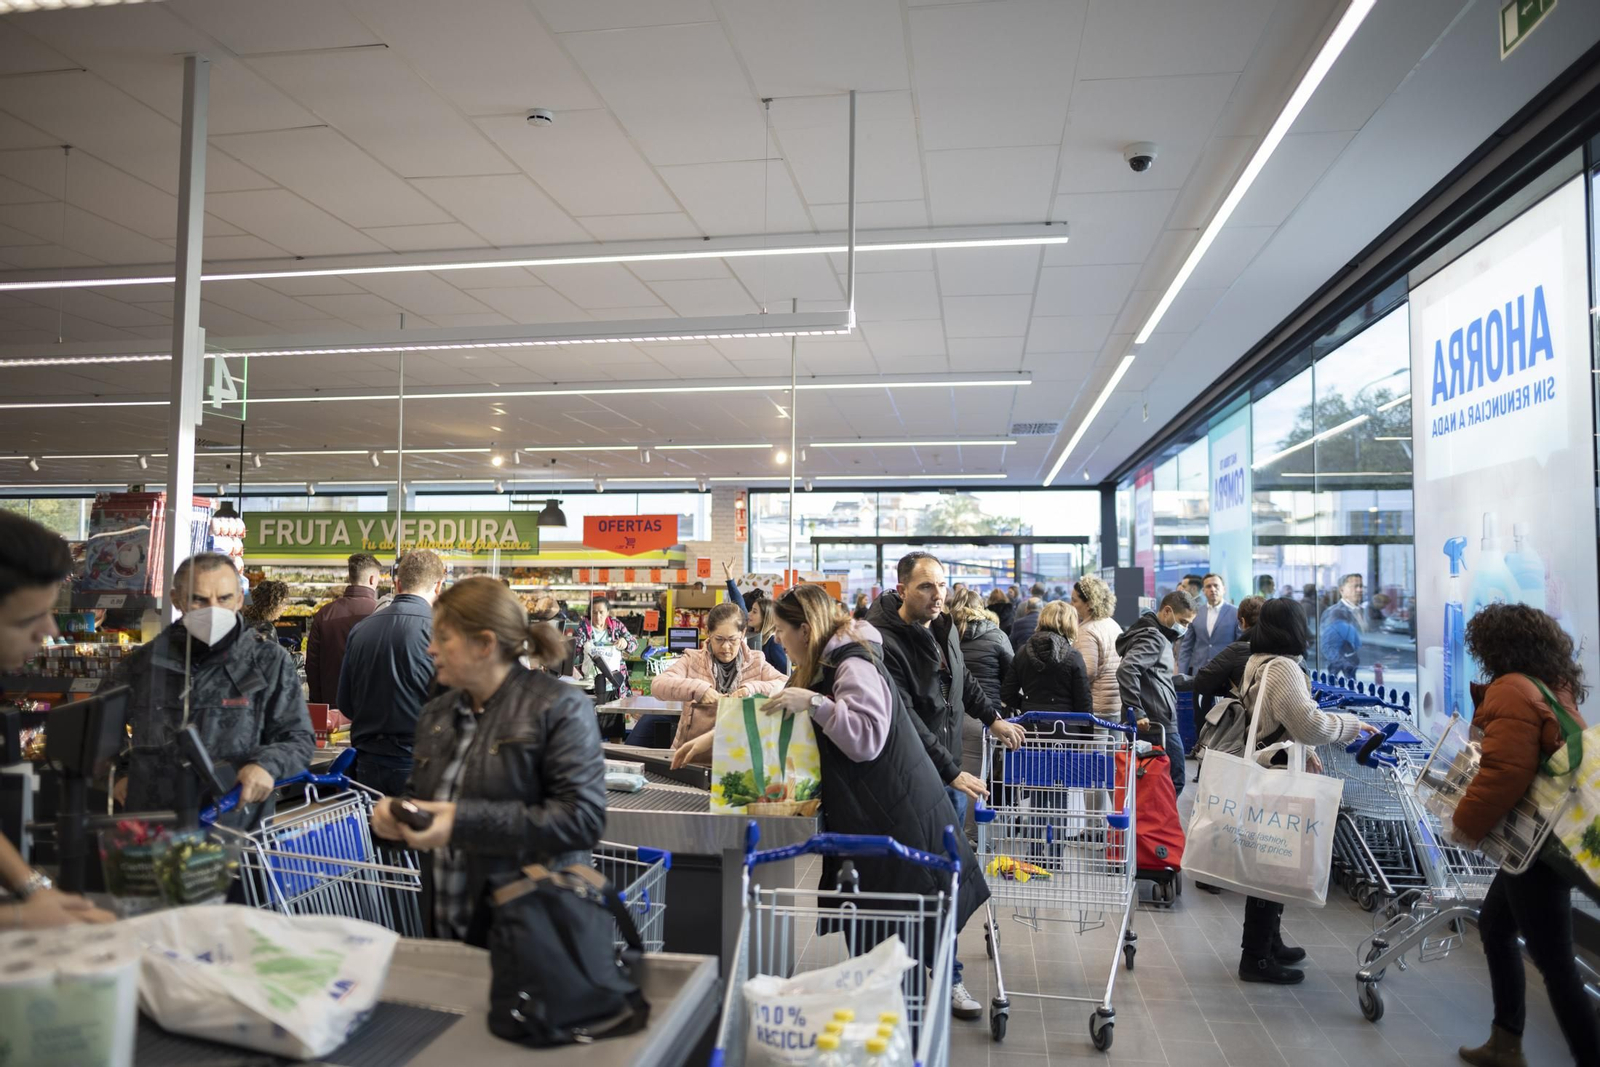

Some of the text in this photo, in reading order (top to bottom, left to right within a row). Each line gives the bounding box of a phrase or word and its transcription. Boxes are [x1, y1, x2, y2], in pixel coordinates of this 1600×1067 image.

[259, 519, 519, 546] FRUTA Y VERDURA
[598, 519, 662, 533] OFERTAS
[361, 538, 377, 550] Tu
[415, 538, 454, 550] diaria
[457, 538, 473, 550] de
[474, 538, 531, 553] frescura
[1207, 794, 1320, 837] PRIMARK
[1233, 838, 1294, 857] Amazing prices
[1256, 831, 1288, 847] fashion,
